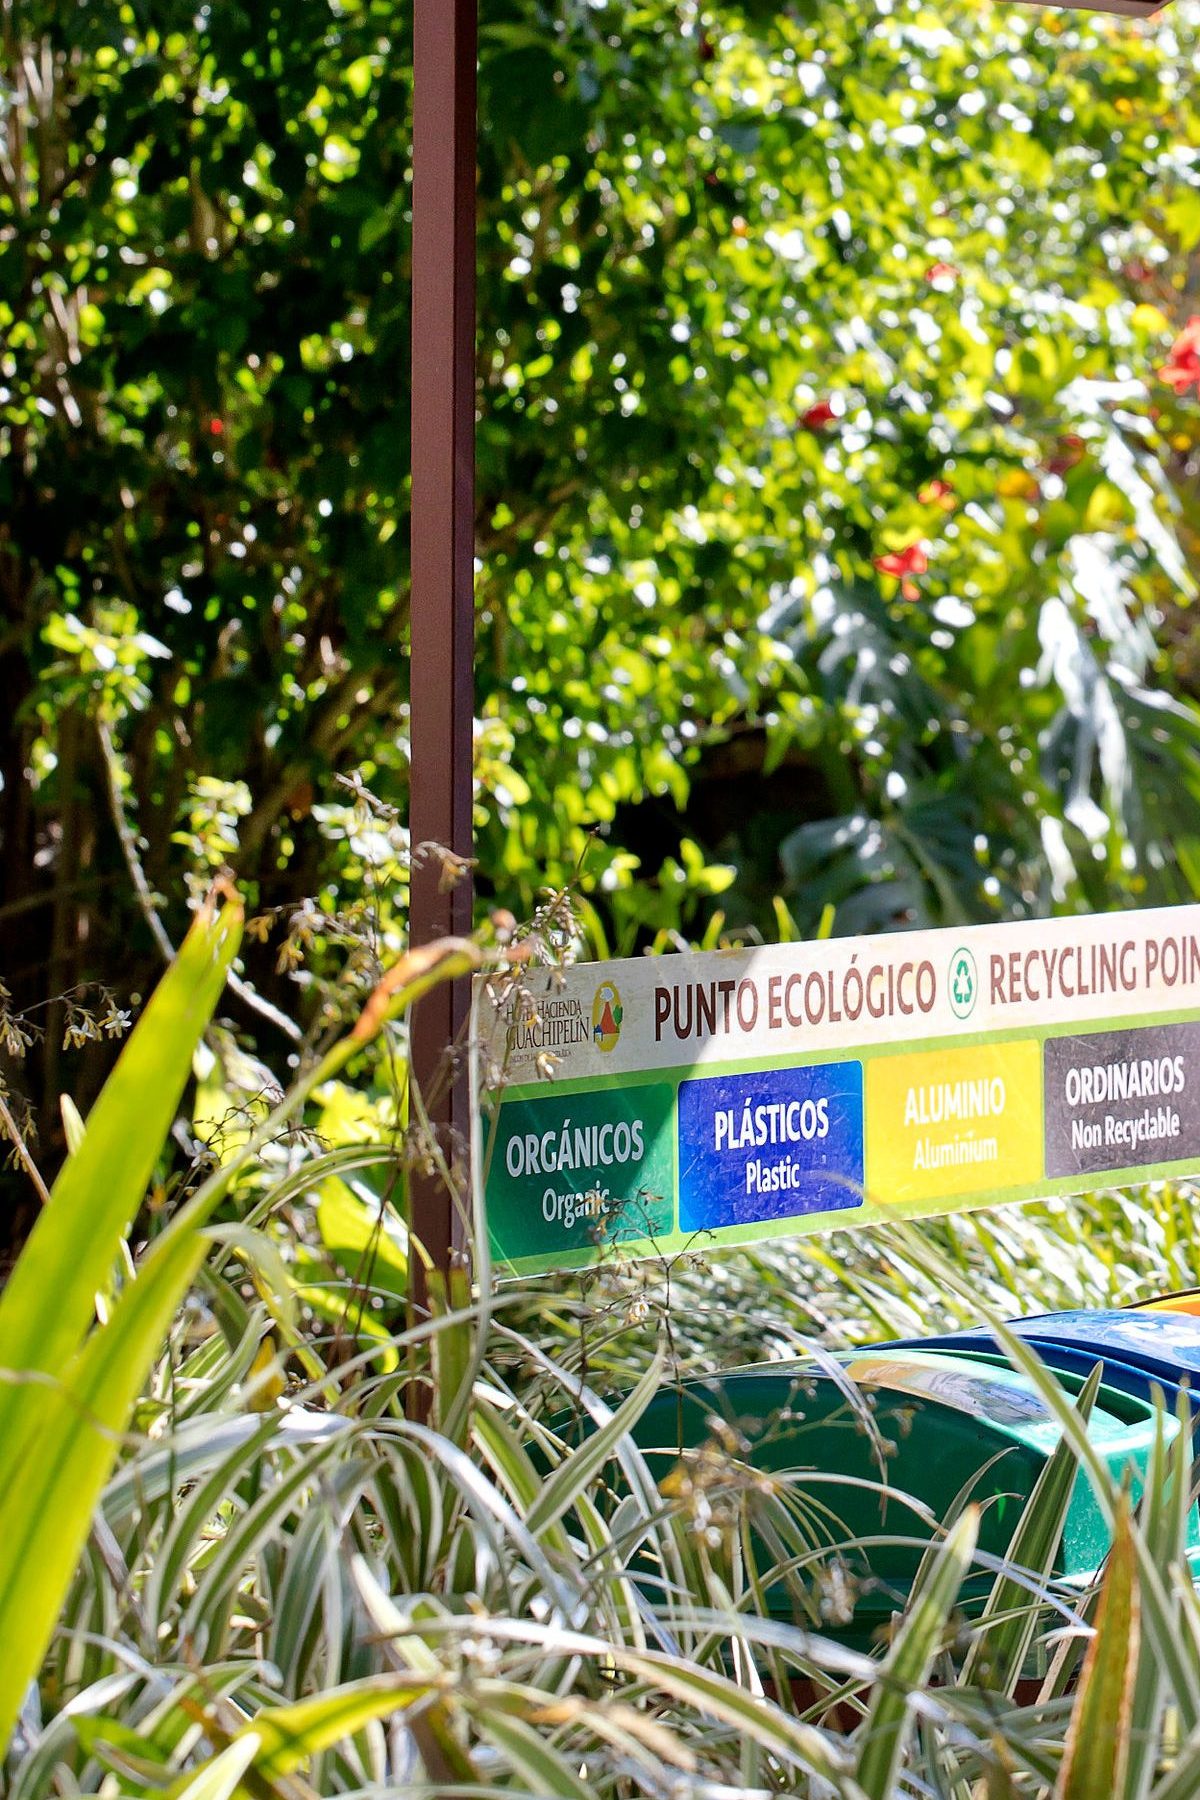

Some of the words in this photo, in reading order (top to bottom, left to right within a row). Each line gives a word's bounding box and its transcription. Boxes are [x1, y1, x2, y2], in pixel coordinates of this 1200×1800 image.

[654, 977, 758, 1042] PUNTO
[768, 954, 937, 1030] ECOLÓGICO
[989, 941, 1137, 1005] RECYCLING
[538, 999, 582, 1020] HACIENDA
[904, 1077, 1006, 1127] ALUMINIO
[1065, 1055, 1185, 1106] ORDINARIOS
[506, 1118, 645, 1178] ORGÁNICOS
[714, 1097, 829, 1151] PLÁSTICOS
[1071, 1118, 1102, 1150] Non
[1105, 1108, 1181, 1150] Recyclable
[745, 1156, 800, 1195] Plastic
[914, 1132, 998, 1171] Aluminium
[542, 1180, 611, 1230] Organic
